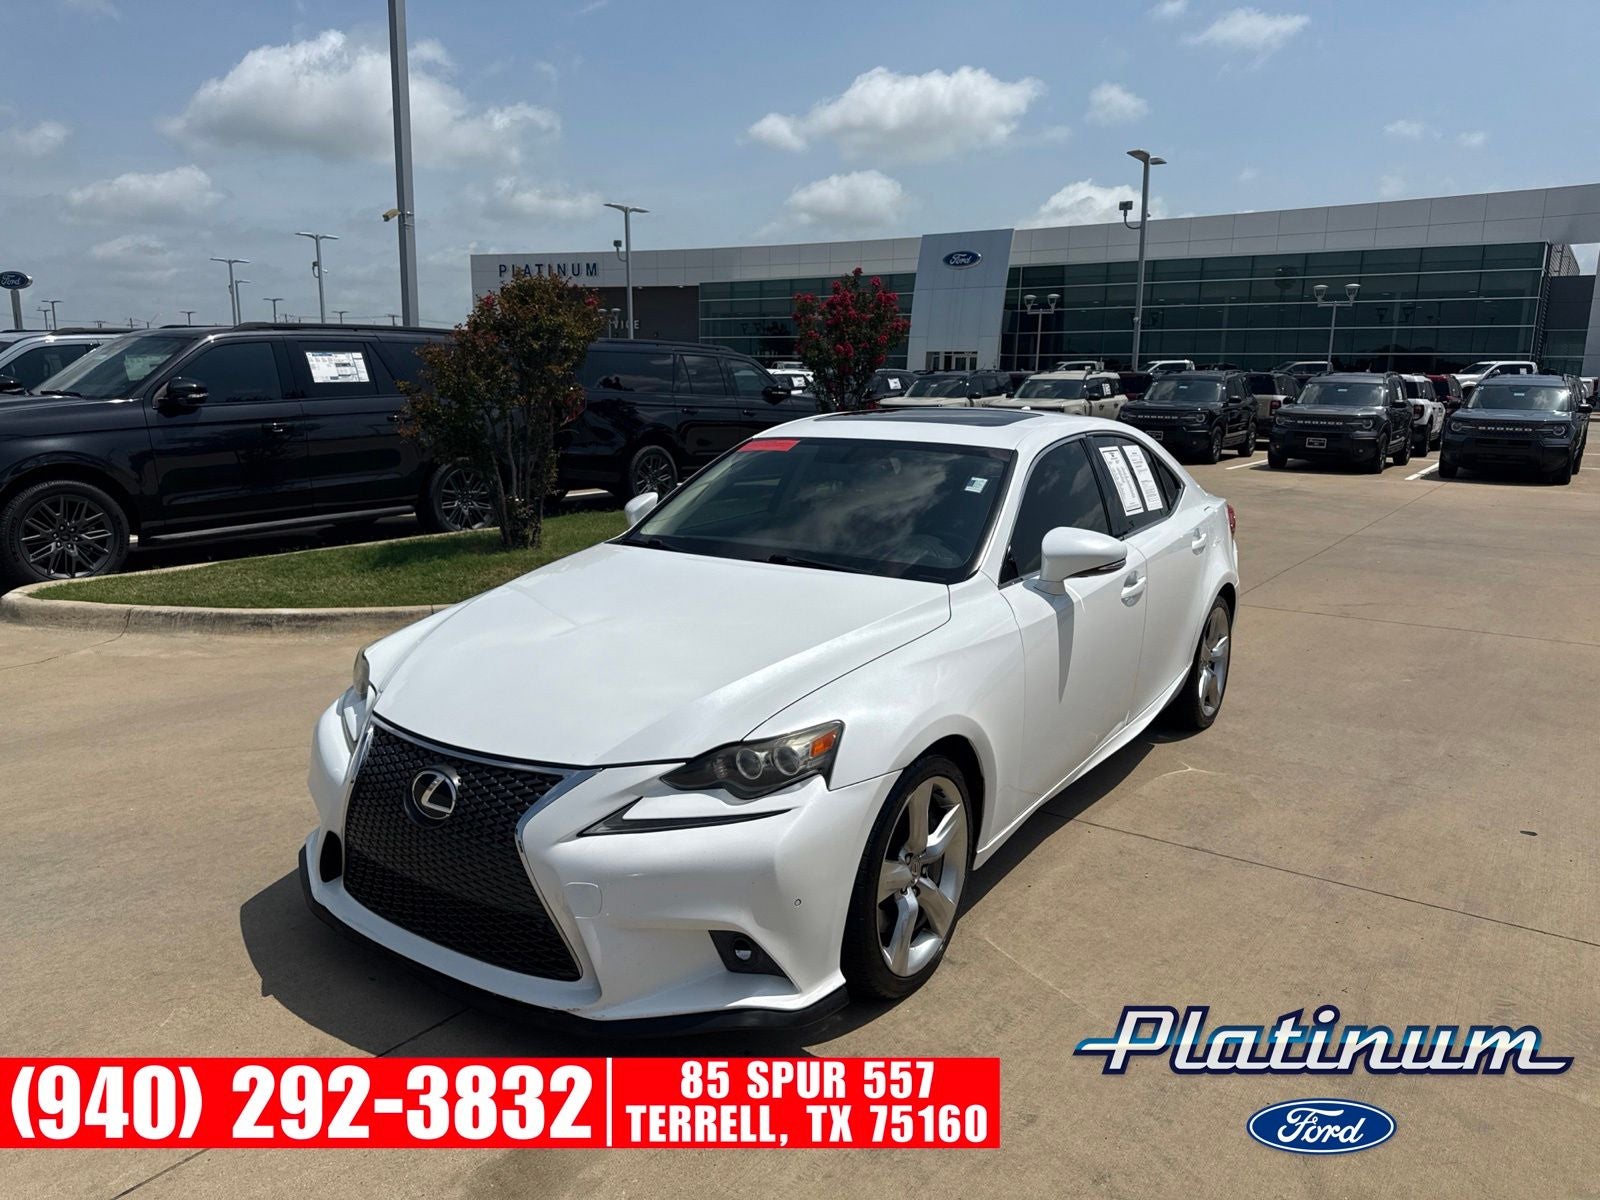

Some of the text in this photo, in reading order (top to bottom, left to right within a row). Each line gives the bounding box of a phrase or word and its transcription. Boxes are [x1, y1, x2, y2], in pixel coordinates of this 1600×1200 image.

[950, 253, 972, 265] Ford
[499, 262, 597, 278] PLATINUM
[1, 273, 21, 286] Ford
